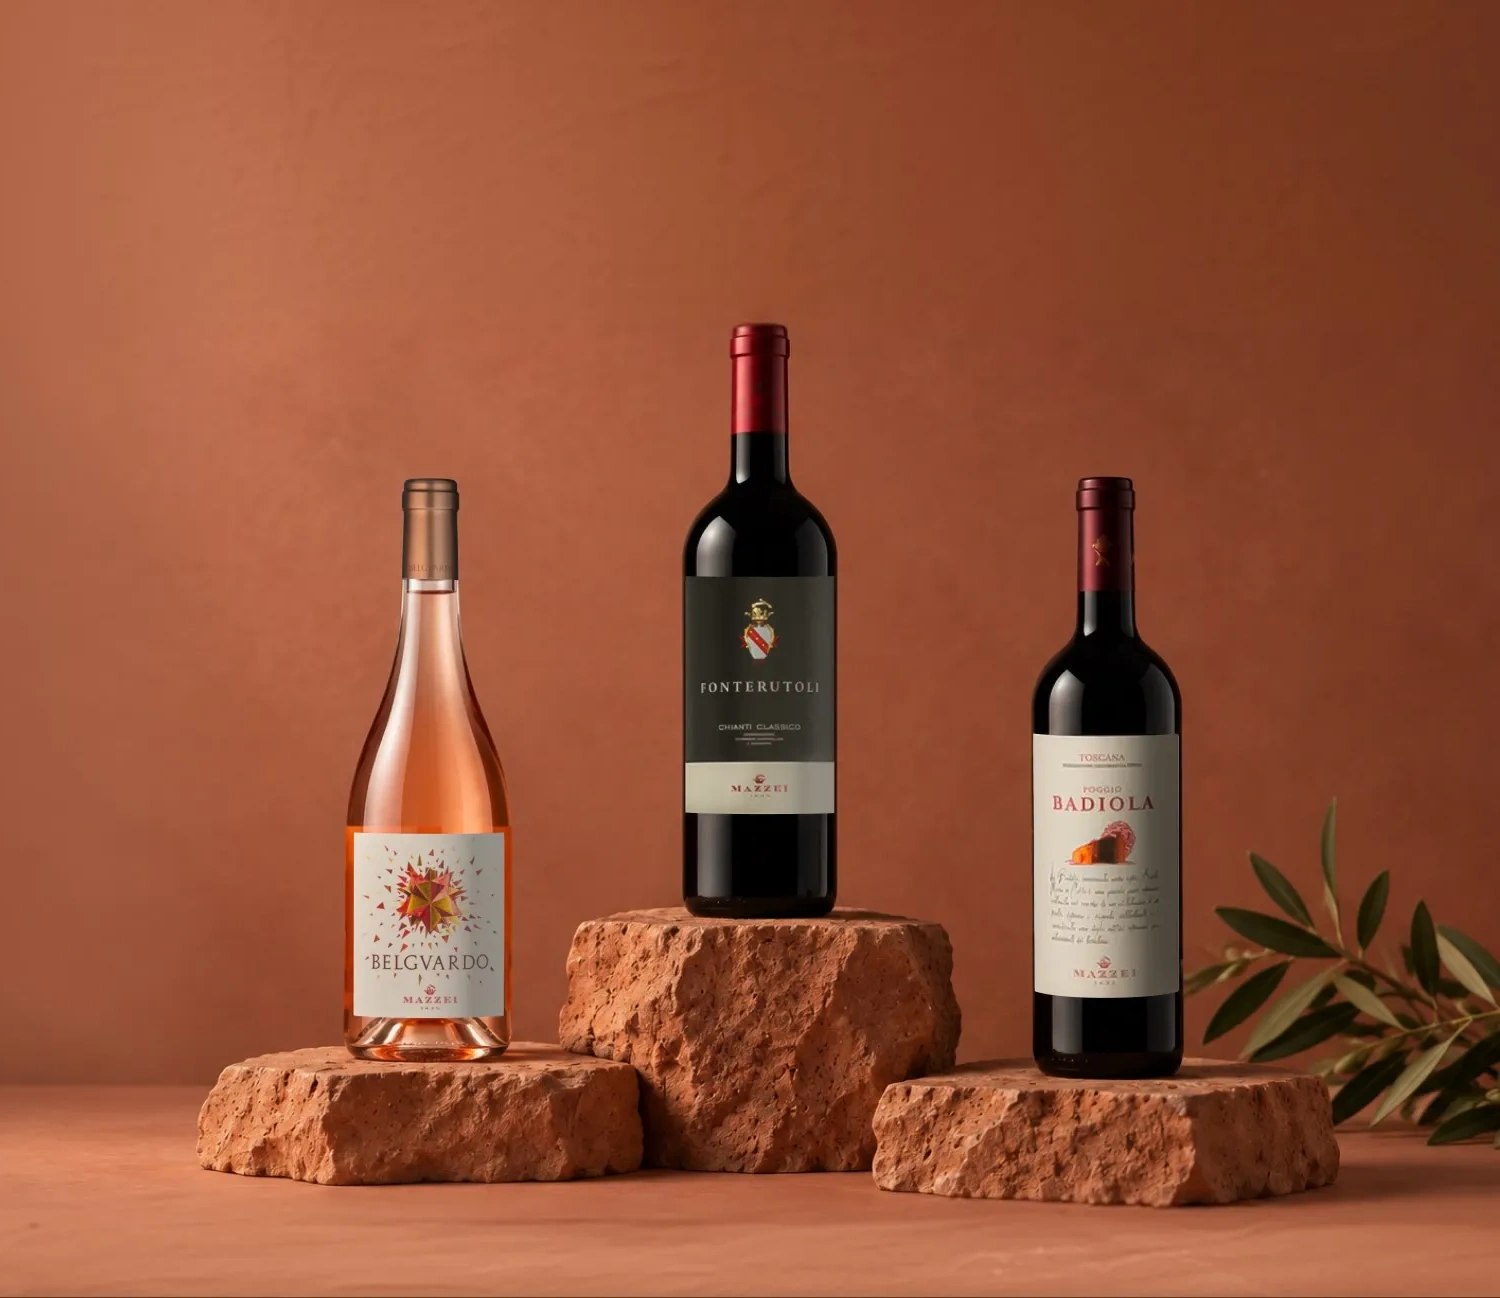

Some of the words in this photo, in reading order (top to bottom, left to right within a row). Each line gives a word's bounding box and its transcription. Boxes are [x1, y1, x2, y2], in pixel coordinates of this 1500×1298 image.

[700, 680, 820, 694] FONTERUTOLI
[718, 723, 752, 731] CHIANTI
[756, 723, 802, 731] CLASSICO
[1079, 753, 1126, 762] TOSCANA
[731, 785, 789, 793] MAZZEI
[1083, 786, 1123, 794] POGGIO
[1052, 795, 1155, 813] BADIOLA
[371, 953, 489, 971] BELGVARDO
[1073, 968, 1137, 979] MAZZEI
[403, 996, 459, 1004] MAZZEI
